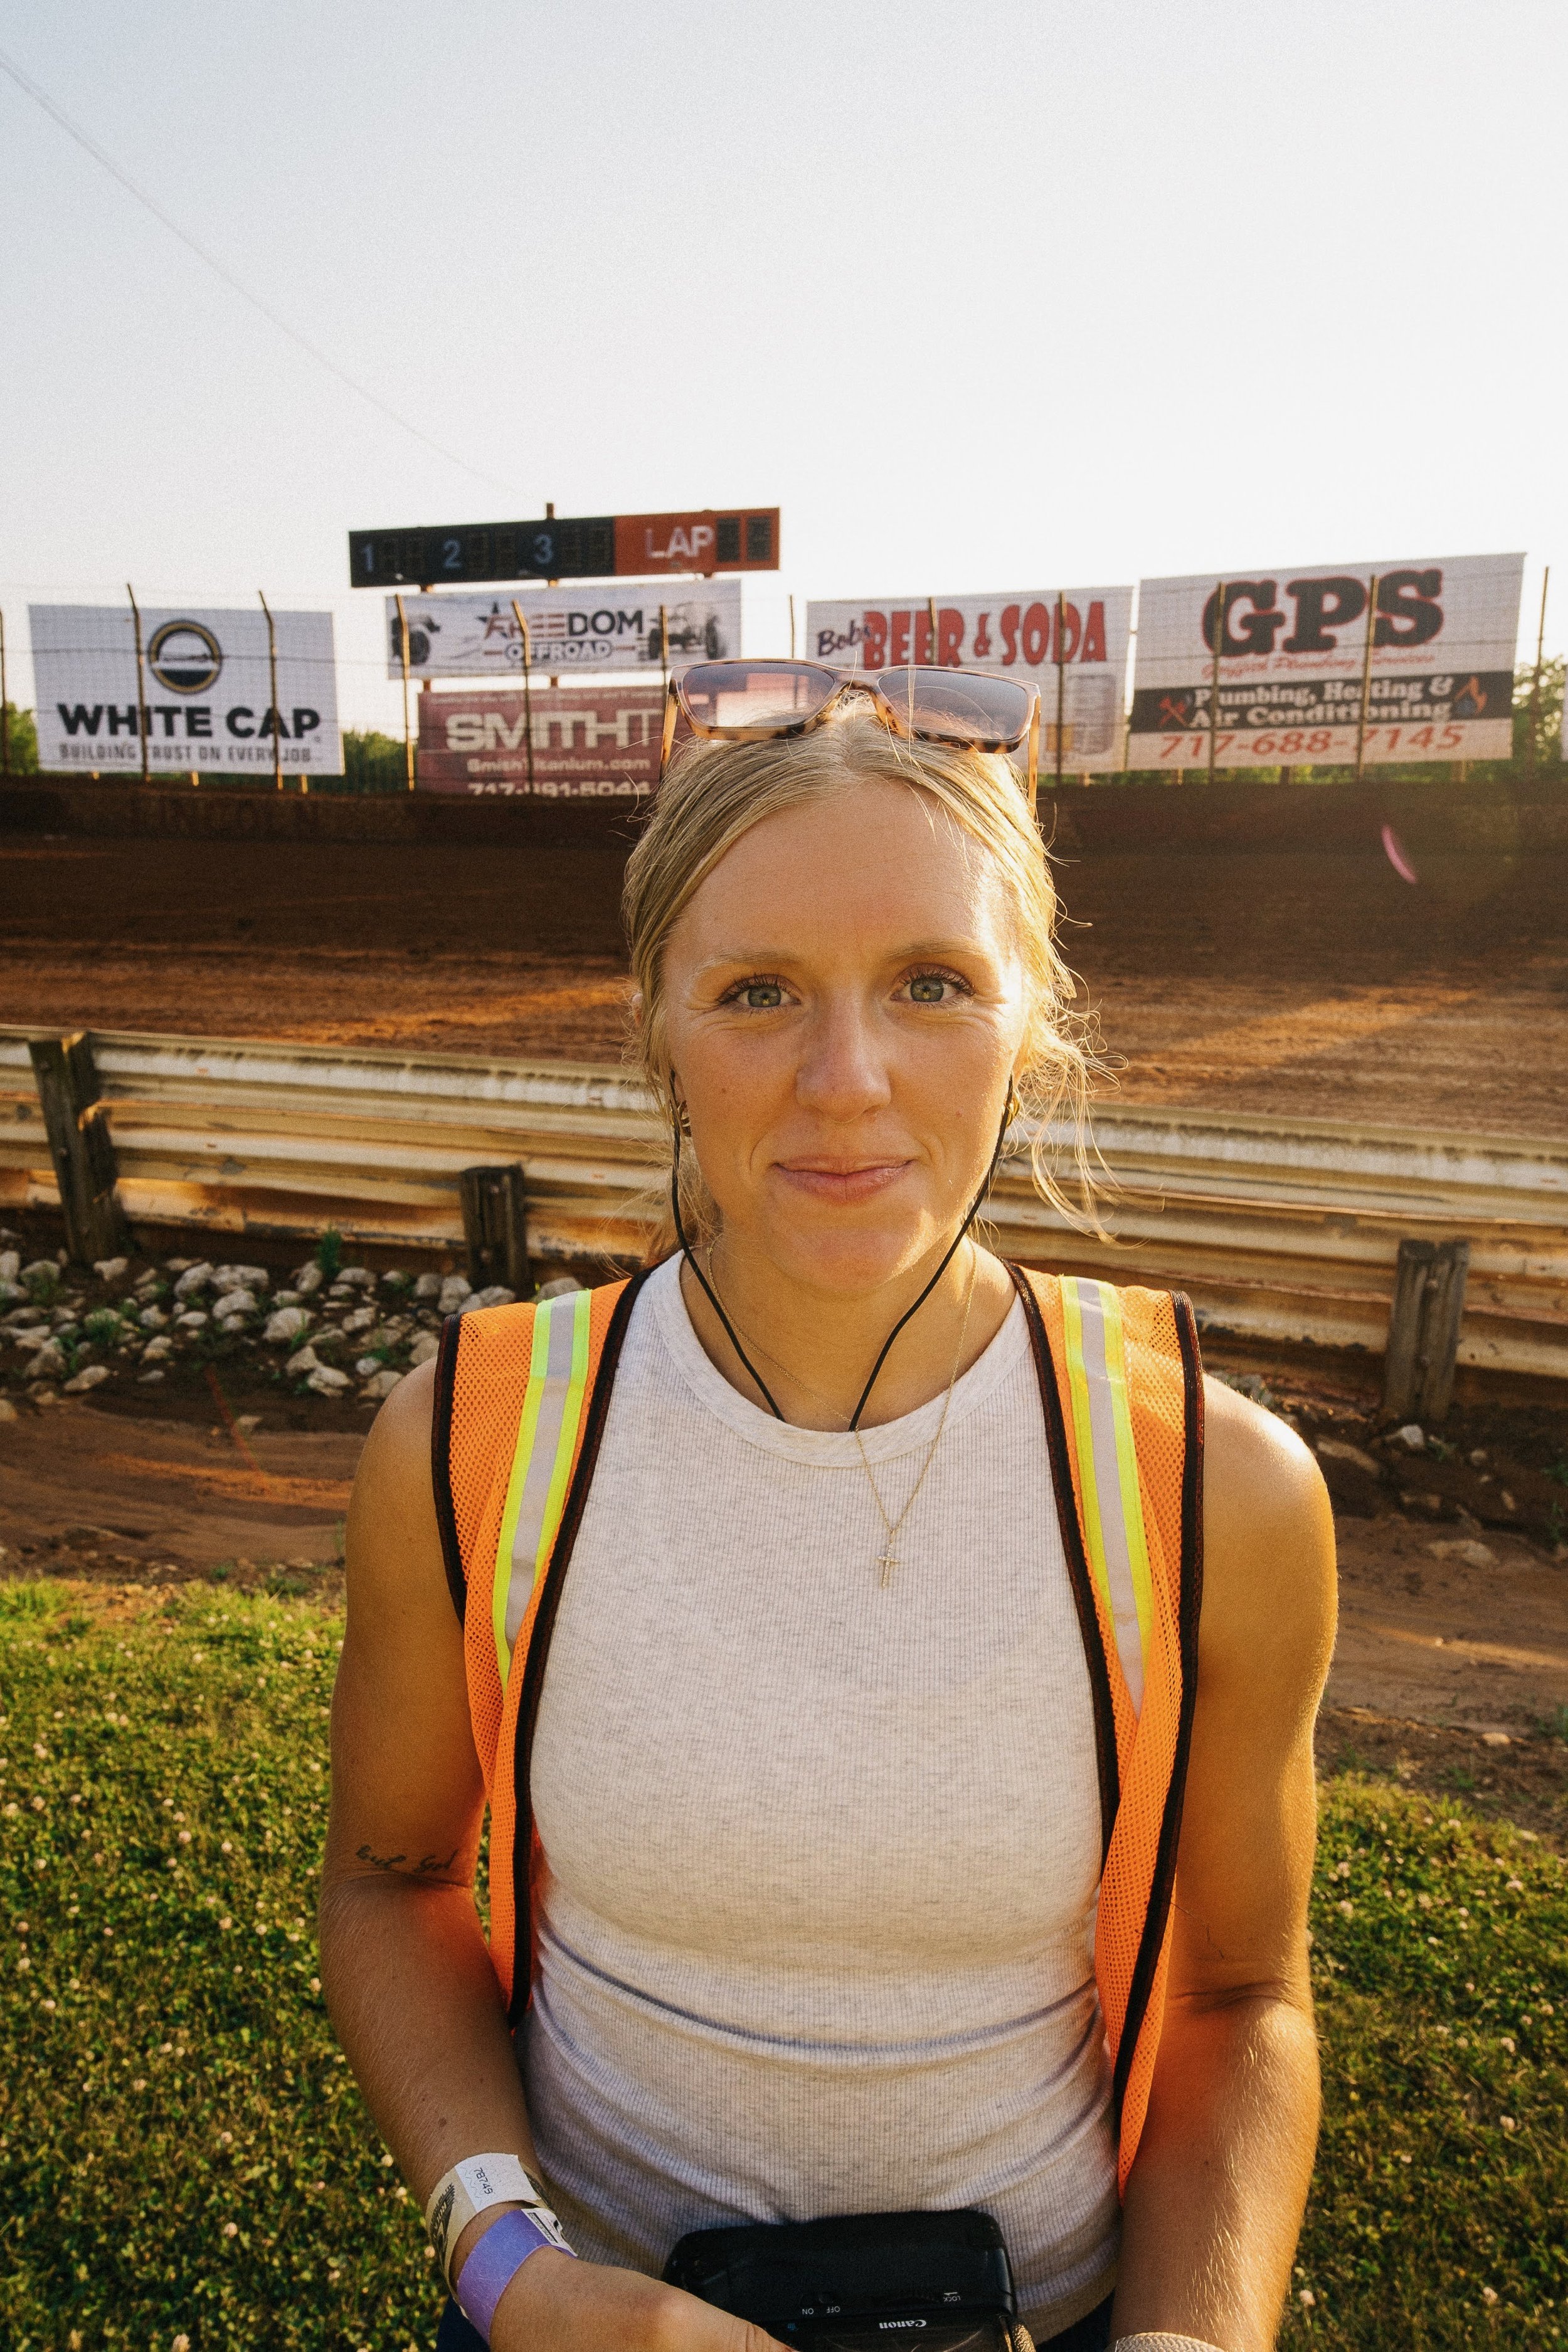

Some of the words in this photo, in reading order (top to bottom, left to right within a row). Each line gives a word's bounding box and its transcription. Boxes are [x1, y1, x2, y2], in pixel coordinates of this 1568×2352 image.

[360, 543, 374, 572] 1
[442, 539, 461, 568] 2
[534, 534, 553, 564] 3
[645, 525, 714, 559] LAP
[1201, 568, 1443, 657] GPS
[863, 608, 965, 670] BEER
[1000, 600, 1106, 665] SODA
[1194, 684, 1316, 707] Pumbing,
[1428, 675, 1454, 696] &
[56, 702, 213, 738] WHITE
[225, 706, 320, 739] CAP
[1189, 708, 1239, 729] Air
[1246, 699, 1451, 726] Conditioning
[1158, 724, 1468, 760] 717-688-7145
[474, 2167, 493, 2195] 78749
[879, 2319, 927, 2329] Canon
